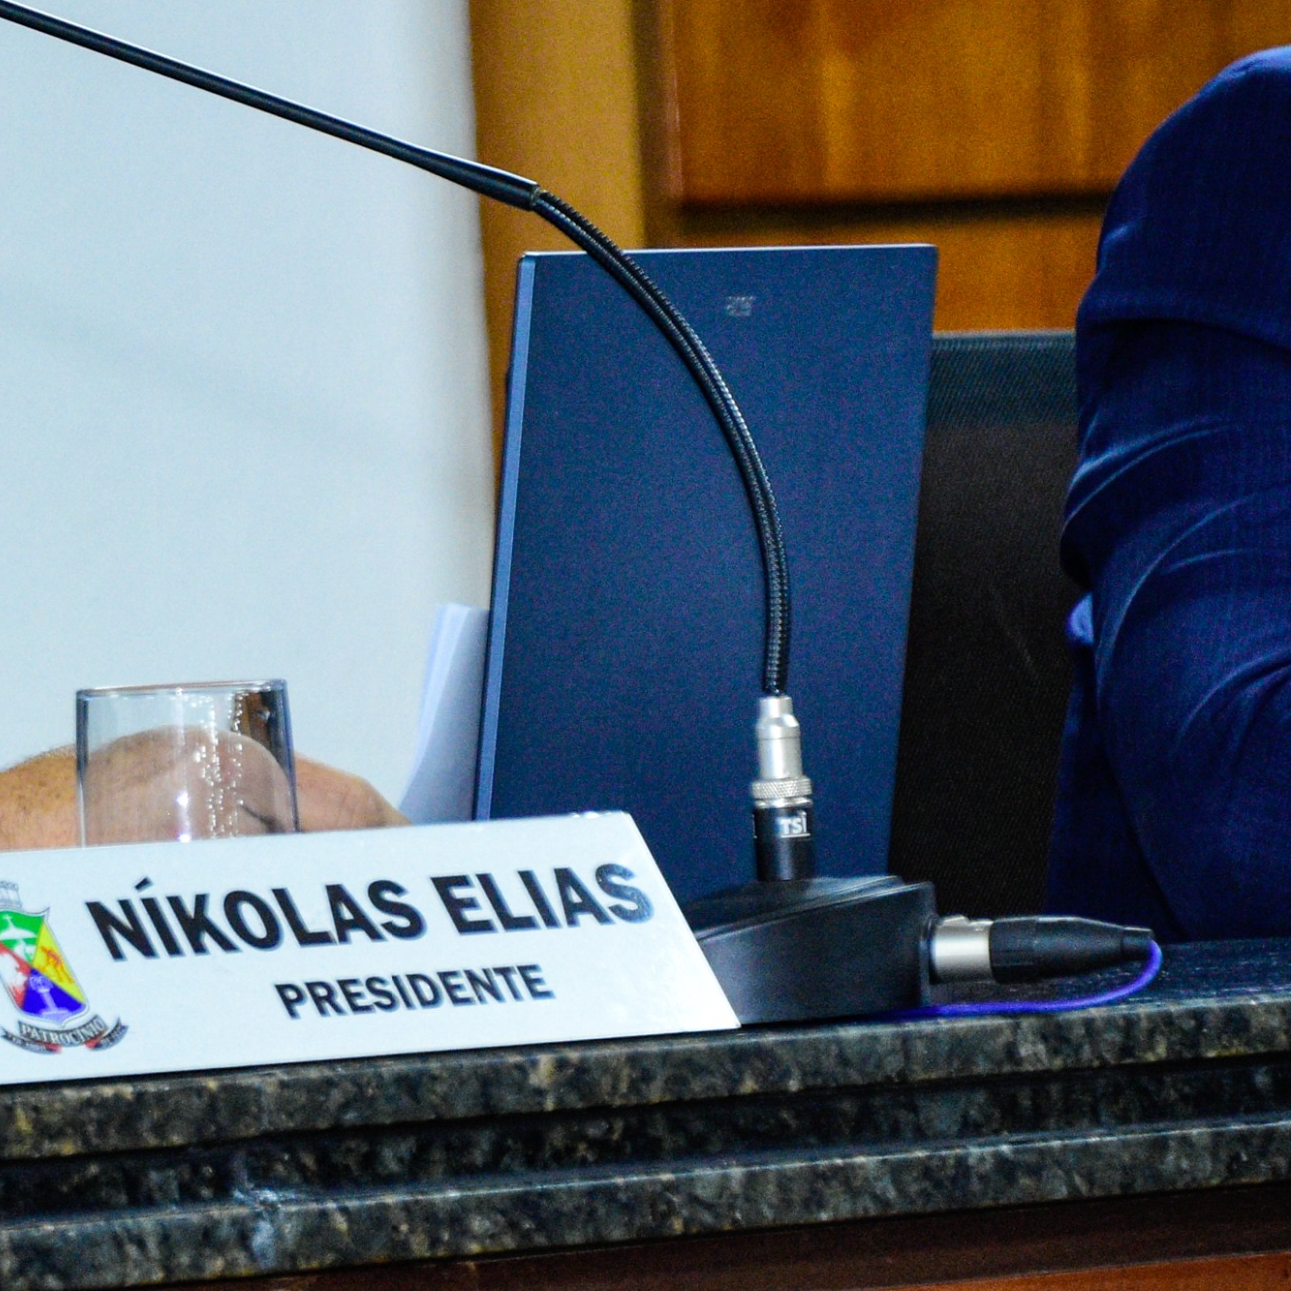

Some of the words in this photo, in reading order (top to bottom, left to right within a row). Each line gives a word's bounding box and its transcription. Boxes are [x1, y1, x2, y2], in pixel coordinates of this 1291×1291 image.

[85, 877, 427, 961] NÍKOLAS
[430, 863, 655, 935] ELIAS
[274, 963, 556, 1019] PRESIDENTE
